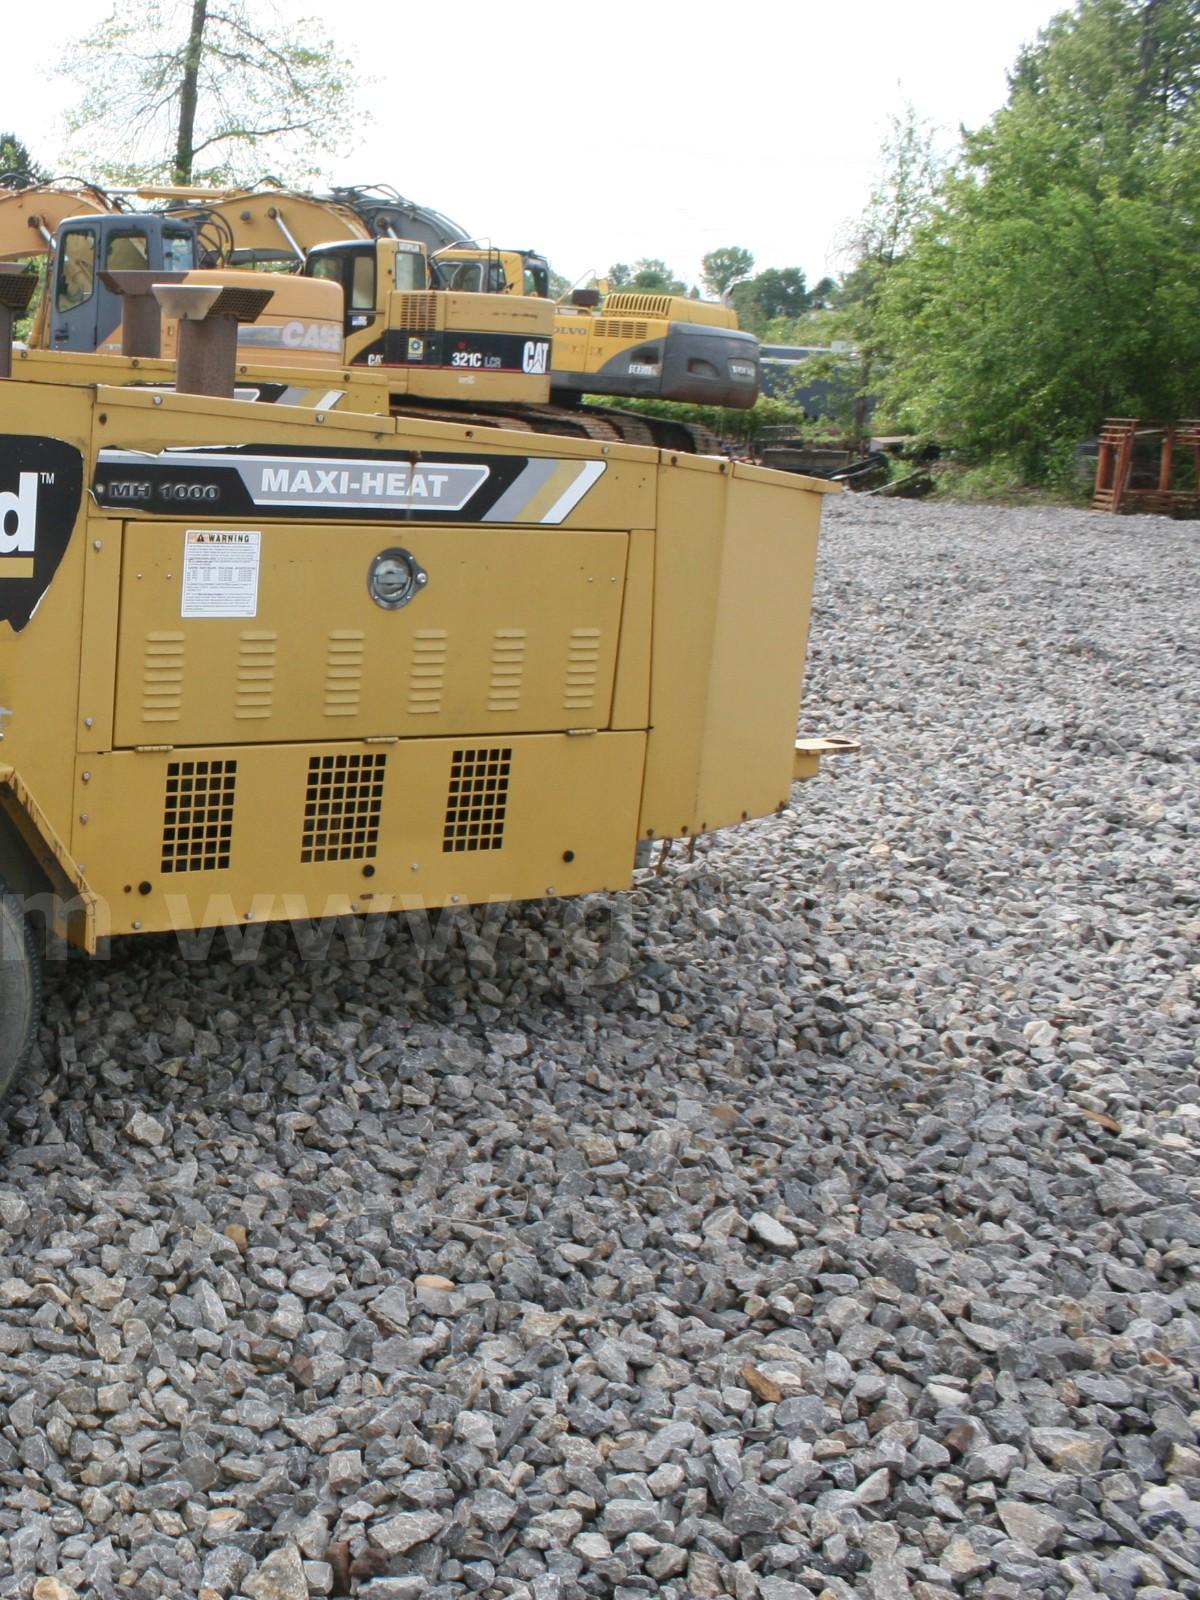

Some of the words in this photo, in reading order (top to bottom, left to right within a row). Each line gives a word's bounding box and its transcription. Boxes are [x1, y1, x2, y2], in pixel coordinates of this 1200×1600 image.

[553, 327, 588, 336] OLVO
[368, 354, 384, 367] CA
[452, 352, 482, 368] 321C
[523, 341, 550, 373] CAT
[111, 482, 150, 499] MH
[160, 484, 219, 501] 1000
[260, 468, 449, 498] MAXI-HEAT
[208, 534, 250, 543] WARNING
